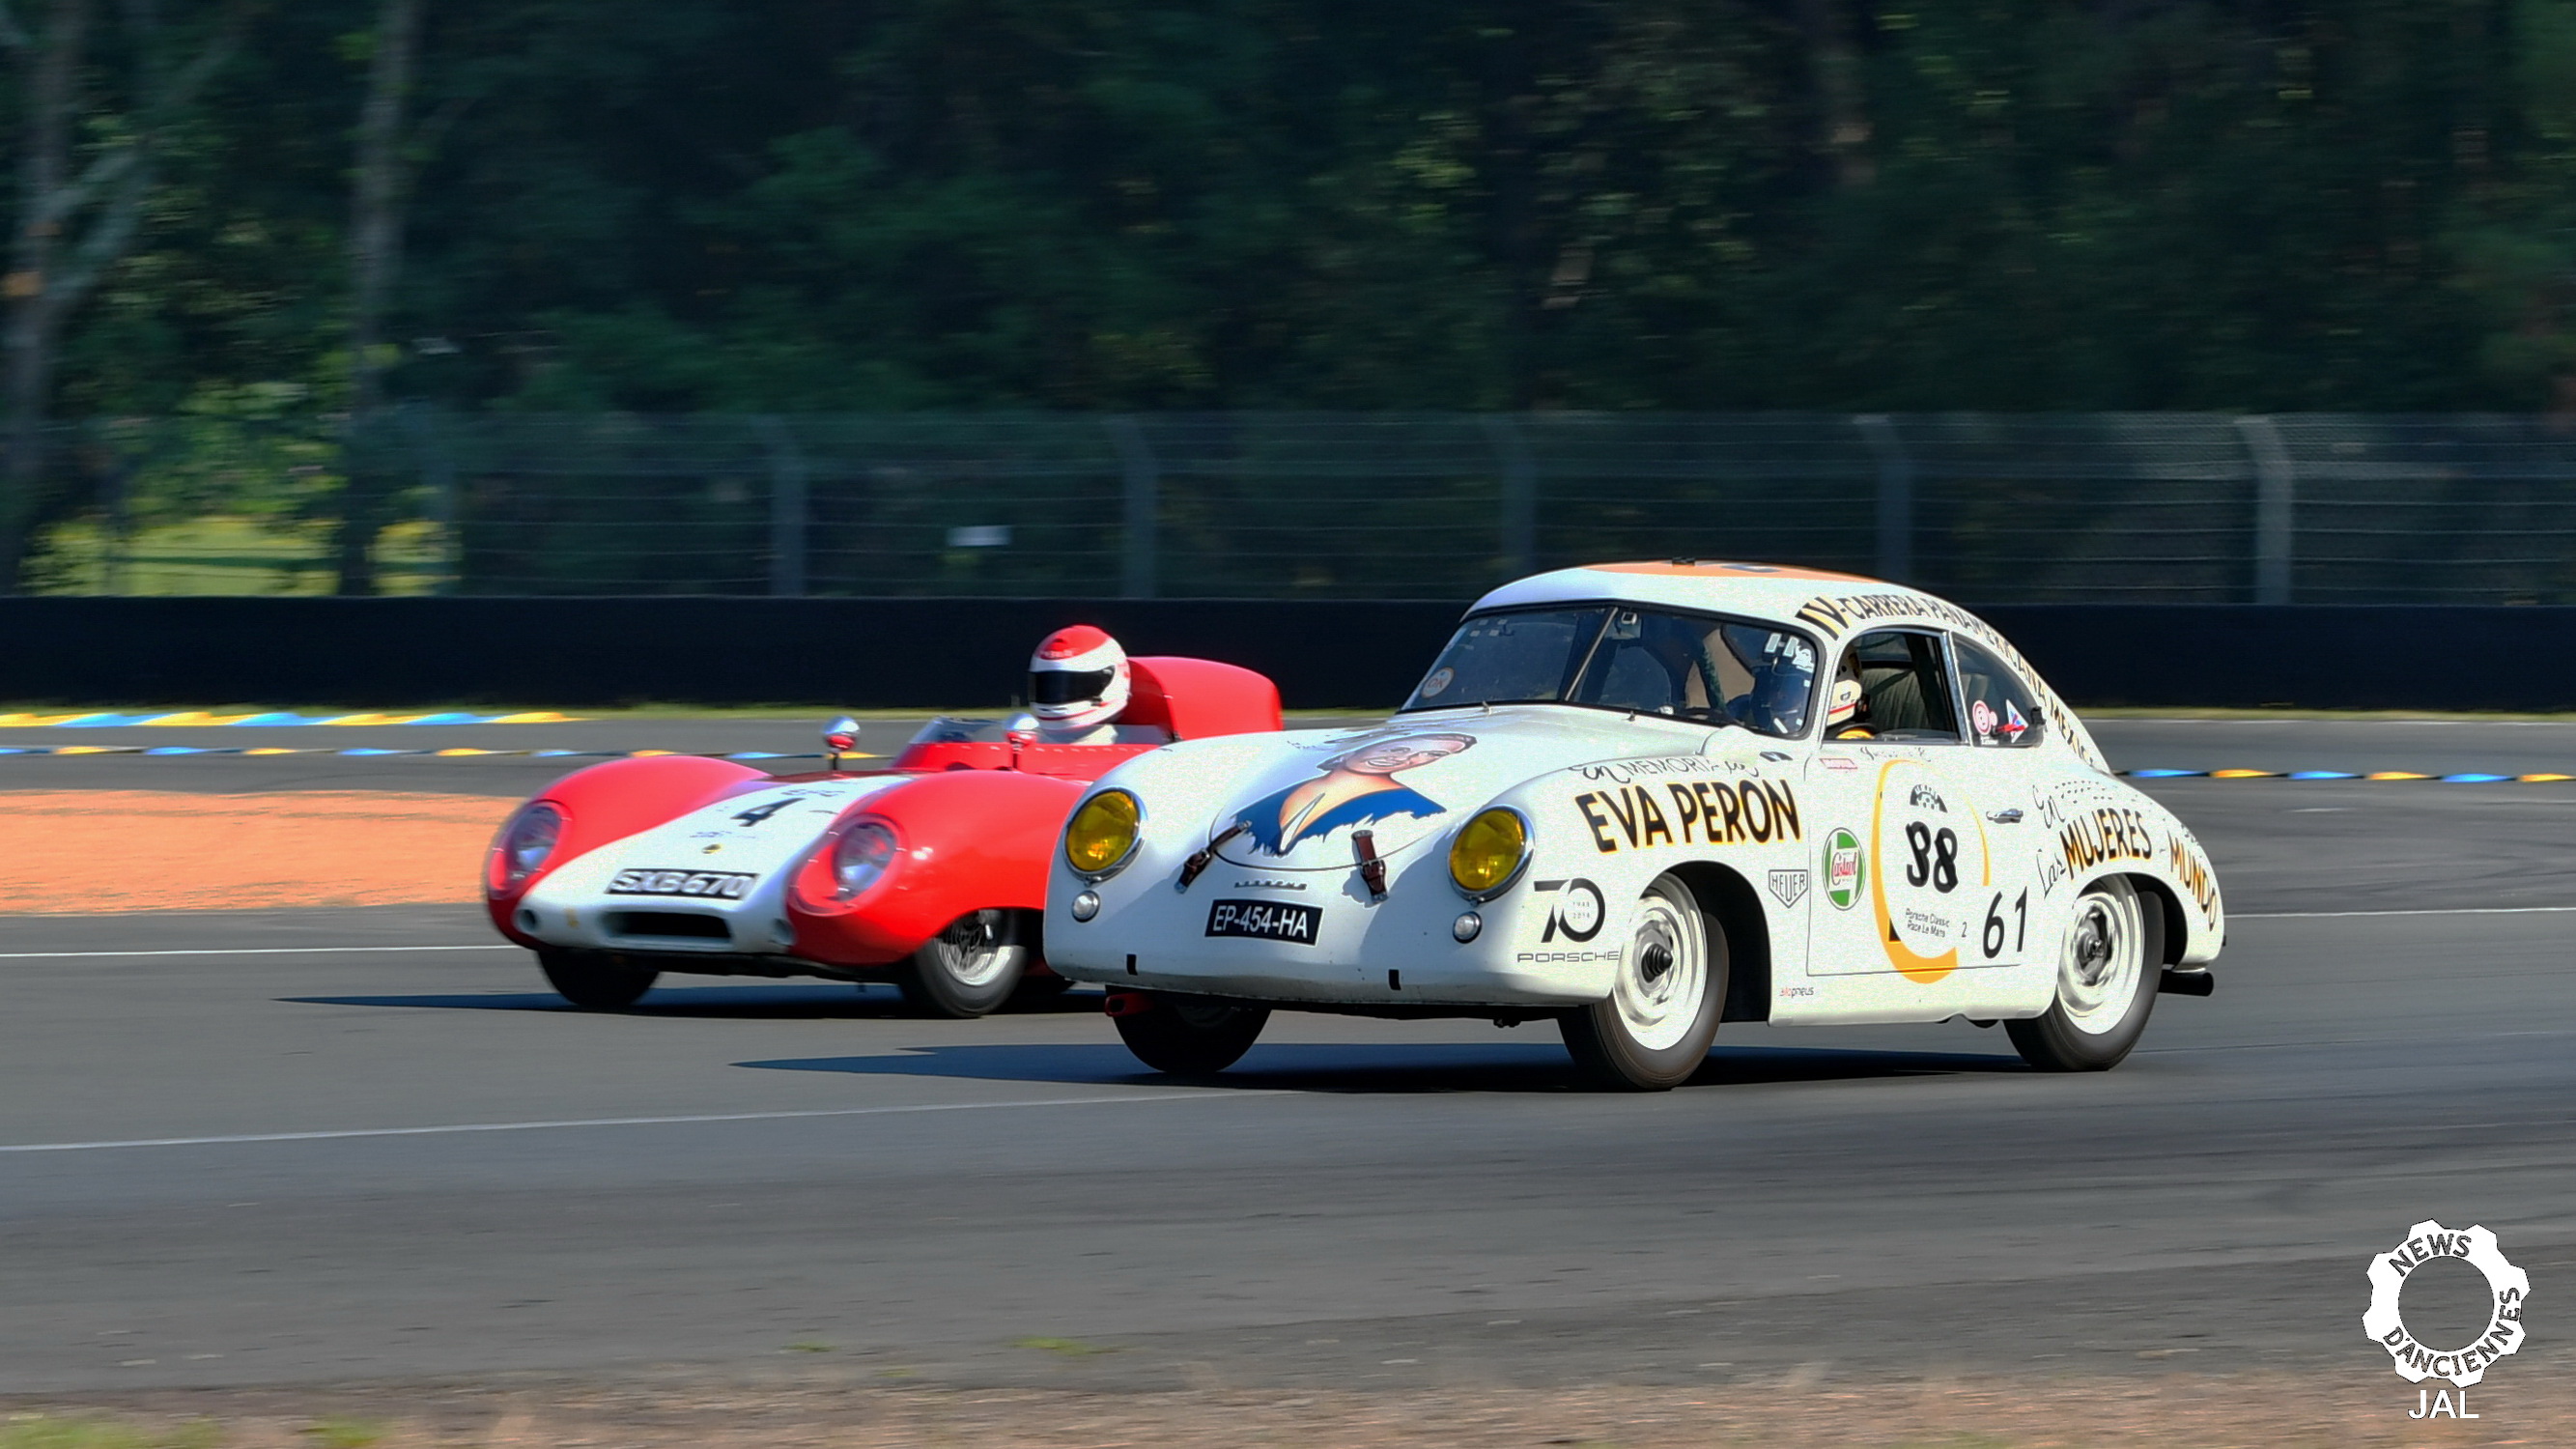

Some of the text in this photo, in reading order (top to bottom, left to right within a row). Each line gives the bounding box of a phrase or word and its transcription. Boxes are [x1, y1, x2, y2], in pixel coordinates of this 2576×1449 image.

[730, 797, 807, 827] 4
[1575, 779, 1802, 853] EVA PERON
[2058, 808, 2153, 881] MUJERES
[610, 870, 756, 898] SXB670
[1771, 873, 1806, 902] HEUER
[2166, 829, 2219, 932] MUNDO
[1212, 904, 1308, 939] EP-454-HA
[1533, 877, 1606, 944] 70
[1982, 886, 2027, 959] 61
[1516, 951, 1620, 963] PORSCHE
